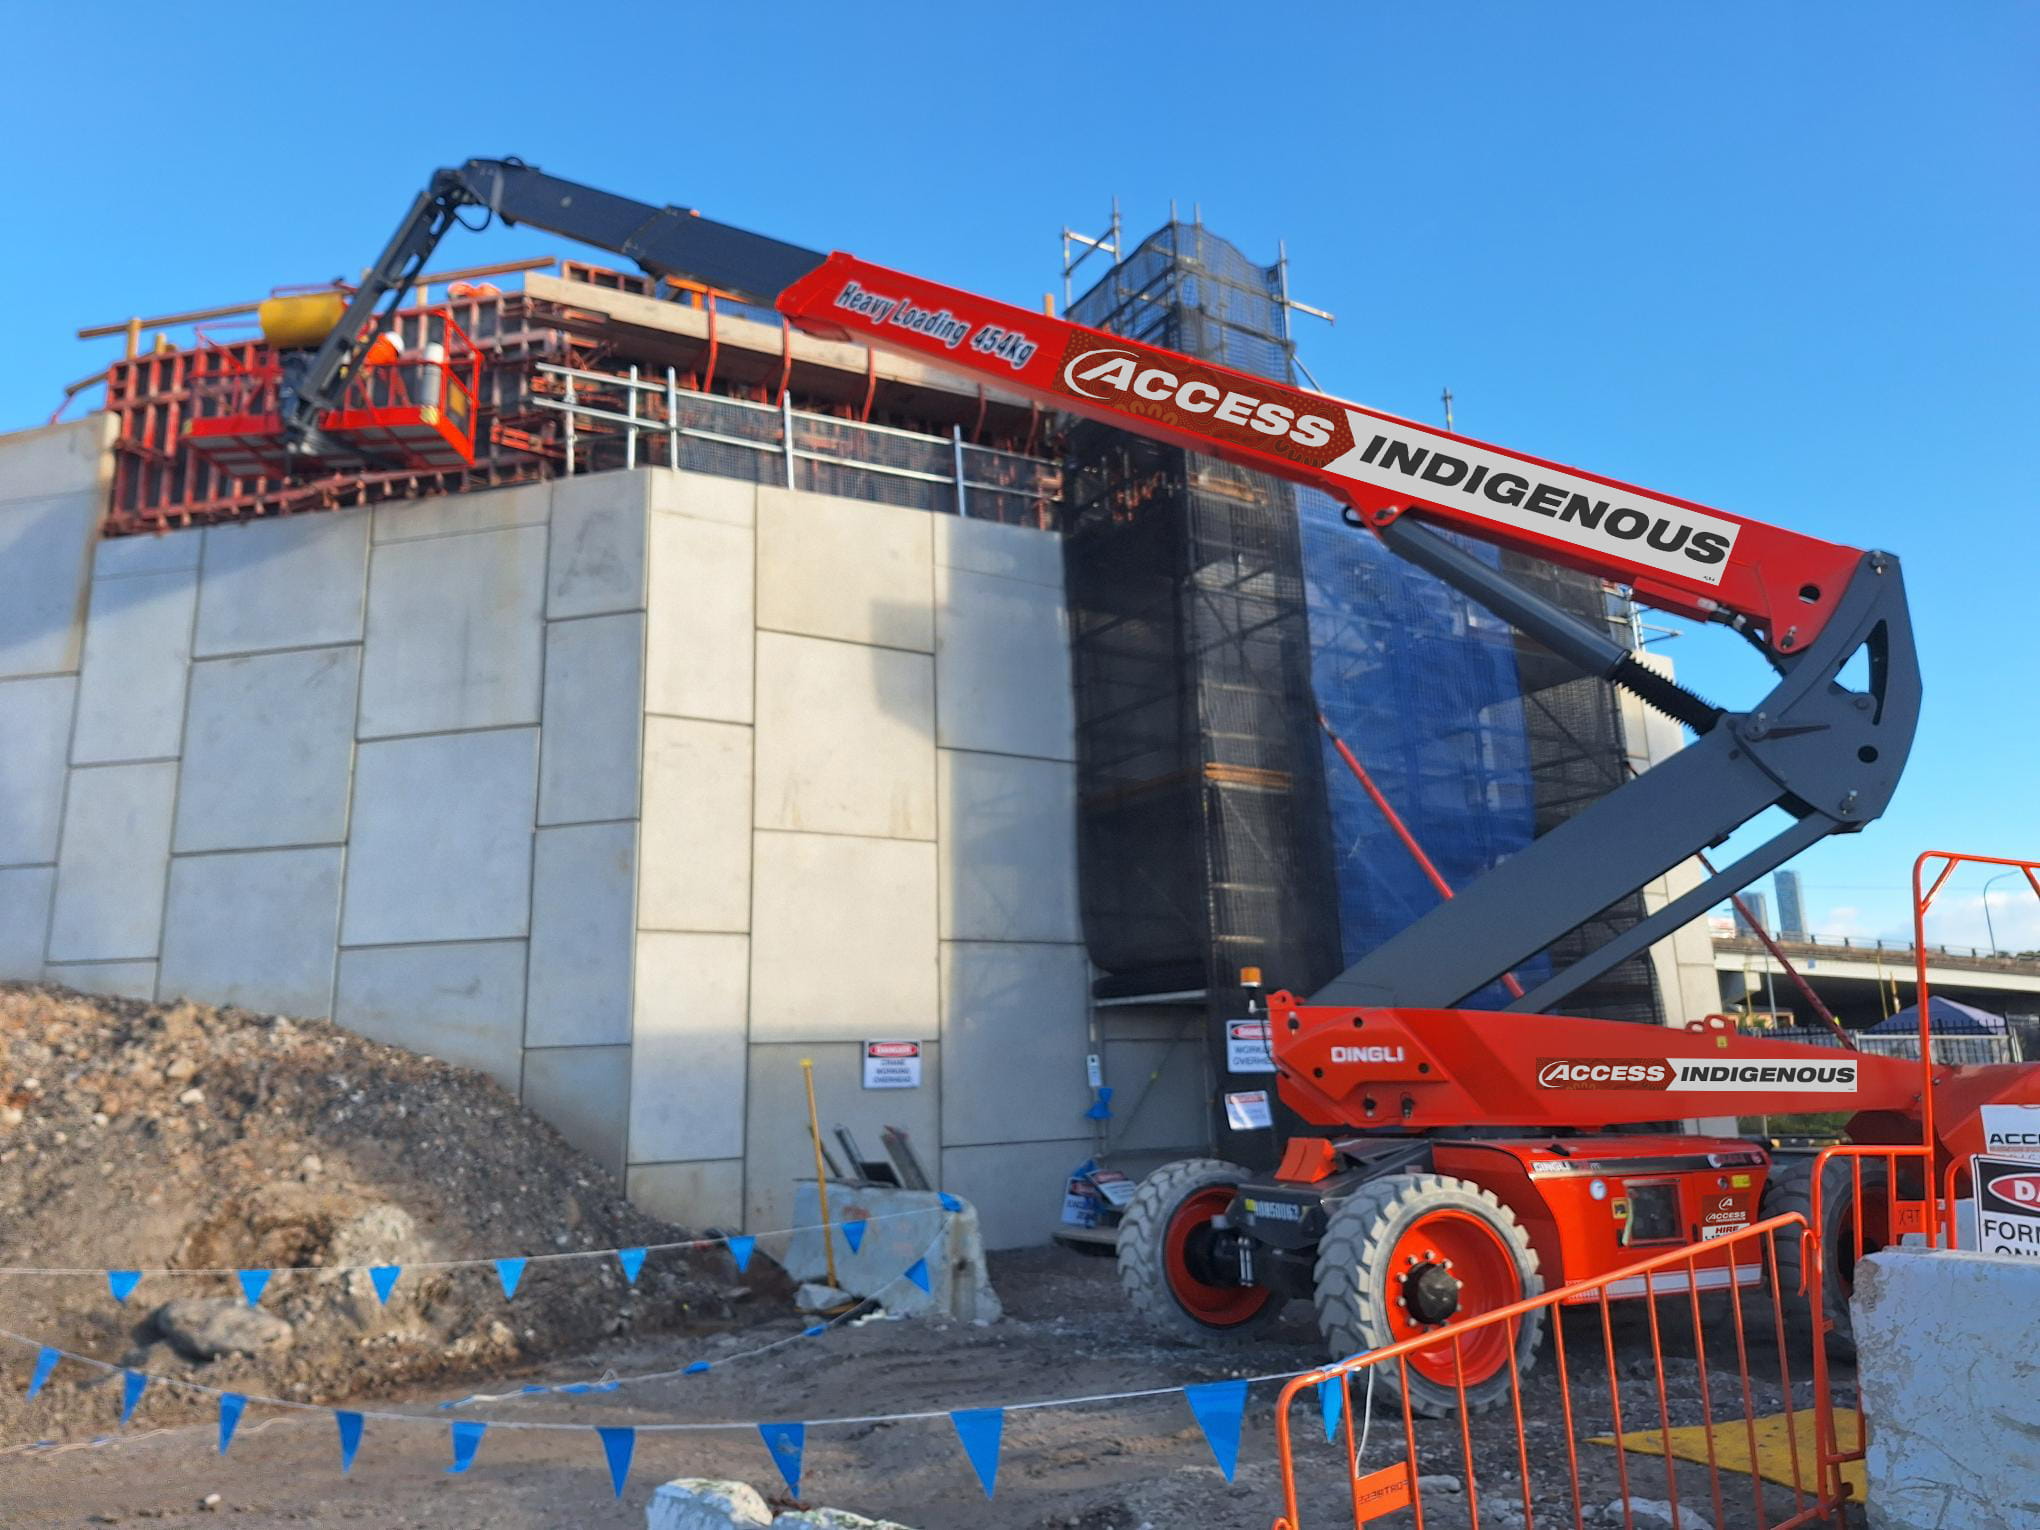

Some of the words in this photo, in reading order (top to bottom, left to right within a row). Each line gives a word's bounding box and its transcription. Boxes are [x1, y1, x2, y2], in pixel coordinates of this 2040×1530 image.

[836, 281, 895, 323] Heavy
[894, 298, 970, 349] Loading
[970, 327, 1038, 369] 454kg
[1063, 348, 1335, 449] ACCESS
[1360, 436, 1731, 565] INDIGENOUS
[1331, 1046, 1405, 1063] DINGLI
[1538, 1060, 1665, 1087] ACCESS
[1680, 1066, 1856, 1083] INDIGENOUS
[1989, 1133, 2040, 1145] ACC
[1706, 1211, 1746, 1221] ACCESS
[1984, 1219, 2040, 1244] FOR
